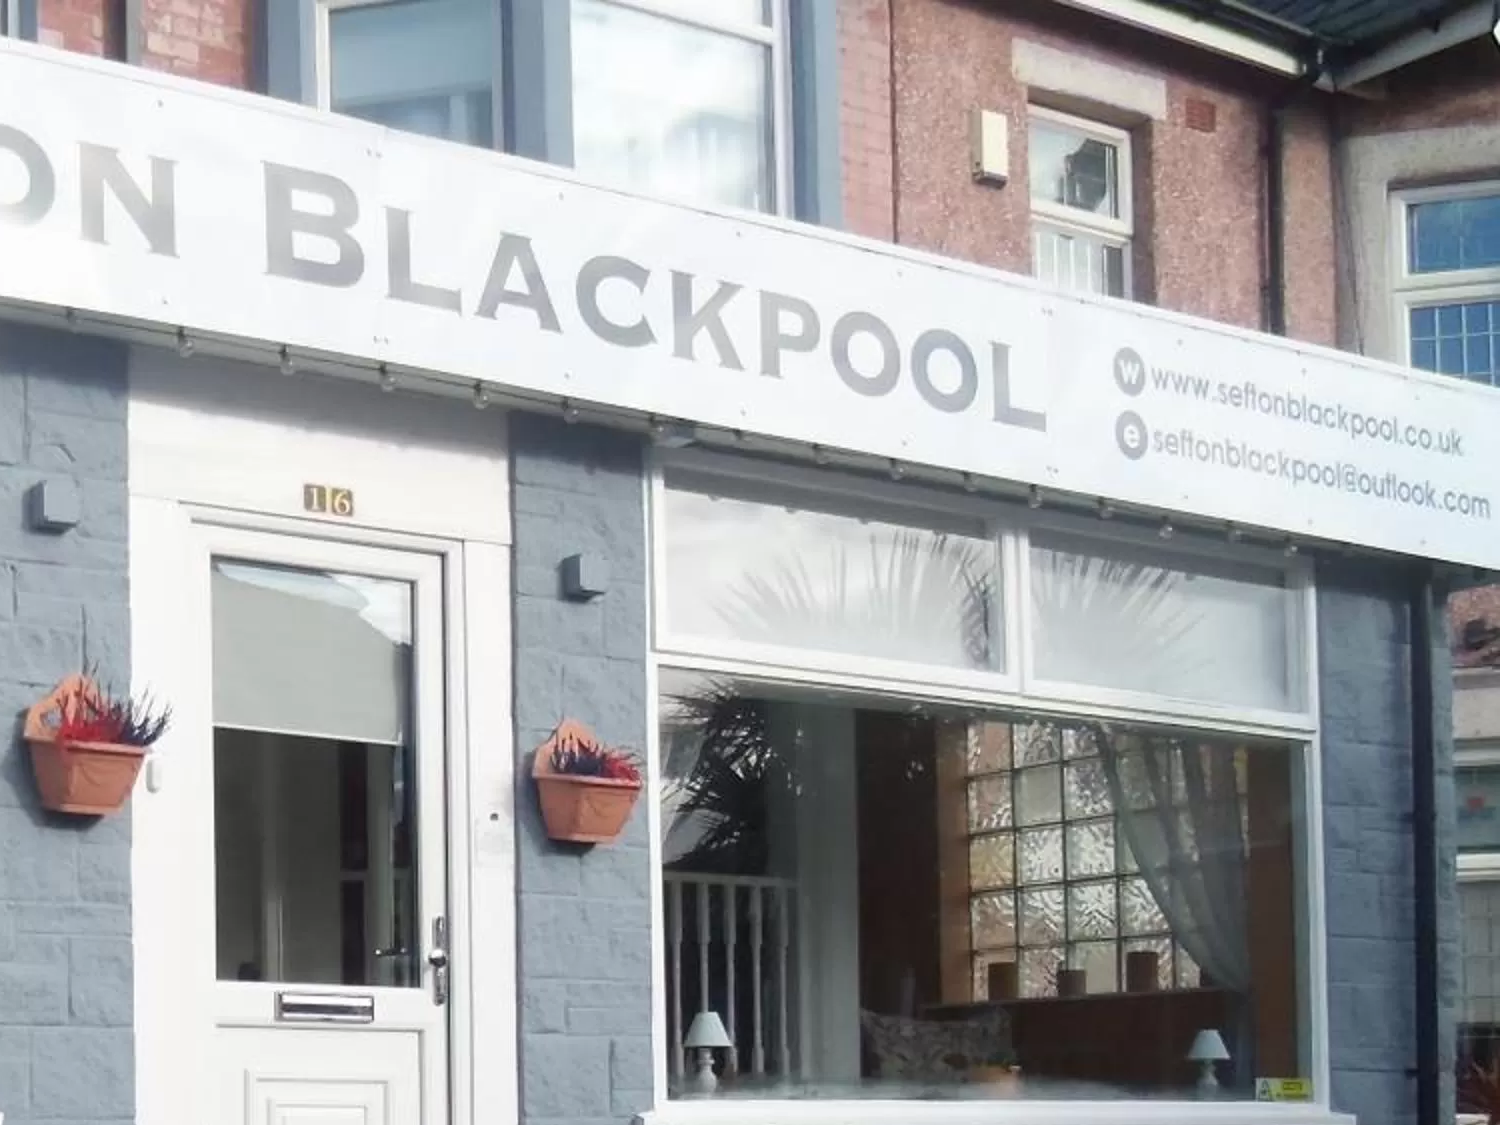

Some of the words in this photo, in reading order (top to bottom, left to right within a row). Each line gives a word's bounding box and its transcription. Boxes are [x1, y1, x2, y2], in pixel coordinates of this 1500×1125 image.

[263, 160, 1047, 431] BLACKPOOL
[1150, 365, 1464, 456] www.seftonblackpool.co.uk
[309, 486, 351, 516] 16
[1152, 426, 1491, 518] seftonblackpool@outlook.com
